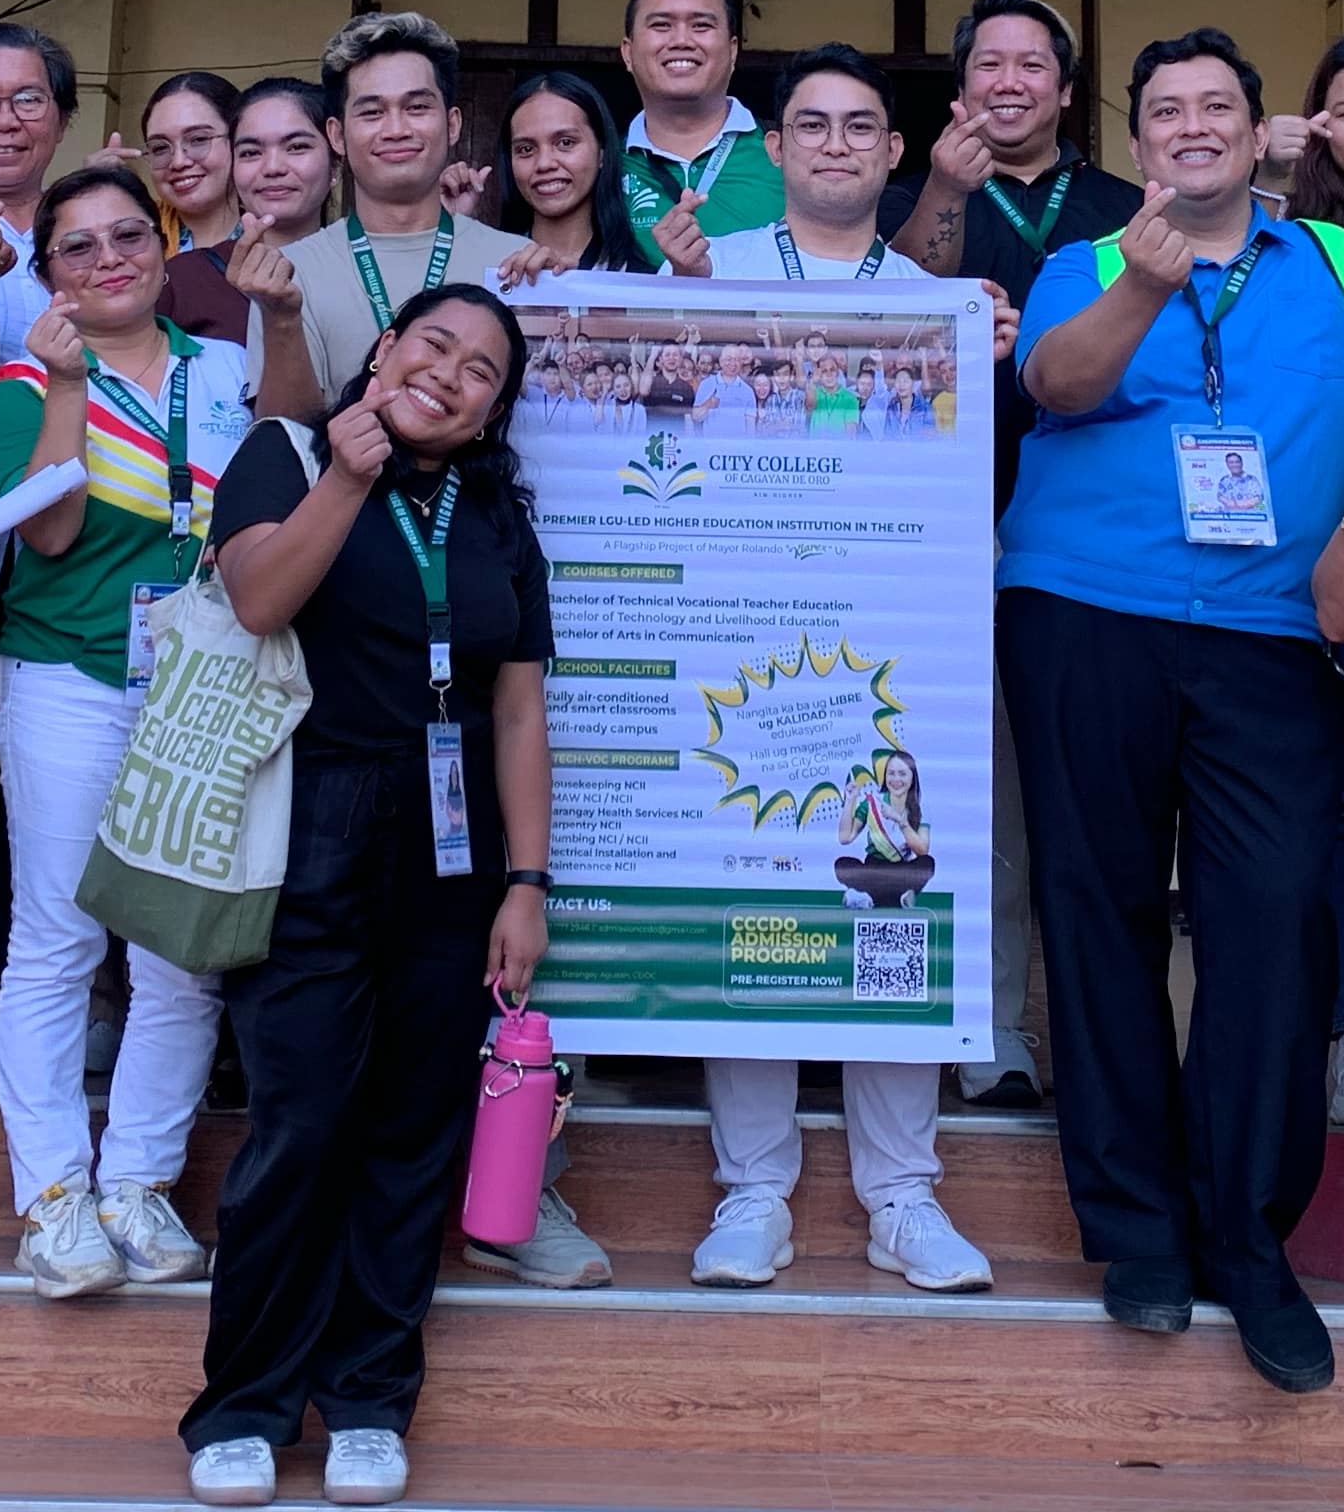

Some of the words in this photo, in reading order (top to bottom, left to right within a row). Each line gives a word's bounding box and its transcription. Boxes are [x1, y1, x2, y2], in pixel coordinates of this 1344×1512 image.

[778, 235, 792, 251] CITY
[360, 254, 372, 268] CITY
[425, 251, 446, 289] IGHER
[709, 455, 753, 471] CITY
[757, 456, 843, 474] COLLEGE
[725, 474, 738, 483] OF
[740, 474, 789, 484] CAGAYAN
[792, 475, 806, 484] DE
[808, 475, 830, 485] ORO
[436, 484, 458, 528] HIGHER
[532, 515, 539, 523] A
[543, 515, 596, 526] PREMIER
[600, 516, 650, 526] LGU-LED
[655, 517, 699, 528] HIGHER
[703, 518, 773, 529] EDUCATION
[777, 520, 851, 531] INSTITUTION
[855, 522, 867, 532] IN
[871, 522, 894, 532] THE
[898, 523, 924, 534] CITY
[604, 541, 611, 550] A
[613, 540, 656, 553] Flagship
[659, 541, 694, 553] Project
[696, 542, 706, 551] of
[708, 543, 739, 554] Mayor
[742, 543, 783, 553] Rolando
[835, 546, 848, 557] Uy
[563, 566, 618, 578] COURSES
[621, 568, 675, 579] OFFERED
[603, 595, 615, 606] of
[618, 596, 674, 606] Technical
[677, 597, 739, 608] Vocational
[743, 598, 788, 609] Teacher
[793, 600, 853, 611] Education
[603, 611, 614, 622] of
[618, 612, 685, 625] Technology
[689, 614, 711, 624] and
[715, 614, 776, 626] Livelihood
[780, 616, 839, 627] Education
[553, 629, 599, 639] achelor
[602, 629, 614, 640] of
[617, 630, 641, 640] Arts
[645, 630, 655, 641] in
[659, 631, 754, 643] Communication
[557, 662, 605, 673] SCHOOL
[609, 664, 670, 675] FACILITIES
[546, 690, 577, 704] Fully
[577, 691, 669, 703] air-conditioned
[546, 703, 567, 713] and
[571, 705, 605, 714] smart
[610, 705, 676, 715] classrooms
[737, 706, 779, 720] Nangita
[782, 703, 794, 713] ka
[796, 702, 810, 711] ba
[812, 700, 826, 709] ug
[829, 692, 862, 706] LIBRE
[759, 720, 773, 730] ug
[777, 710, 827, 727] KALIDAD
[830, 709, 843, 718] na
[547, 721, 607, 735] Wifi-ready
[610, 725, 658, 736] campus
[771, 721, 833, 740] edukasyon?
[790, 734, 862, 754] magpa-enroll
[167, 729, 223, 775] CEBU
[791, 757, 811, 768] City
[814, 749, 854, 763] College
[553, 753, 609, 764] TECH-VOC
[612, 755, 674, 766] PROGRAMS
[789, 770, 799, 781] of
[552, 780, 621, 792] ousekeeping
[624, 781, 646, 790] NCII
[583, 794, 601, 803] NCI
[611, 794, 632, 803] NCII
[552, 809, 597, 818] arangay
[598, 808, 632, 817] Health
[635, 808, 678, 818] Services
[681, 810, 703, 819] NCII
[553, 821, 597, 831] arpentry
[600, 821, 621, 830] NCII
[598, 835, 616, 844] NCI
[627, 835, 648, 845] NCII
[551, 848, 592, 857] lectrical
[595, 848, 653, 858] Installation
[656, 850, 676, 859] and
[615, 863, 636, 872] NCII
[588, 899, 612, 911] US:
[731, 916, 798, 932] CCCDO
[731, 932, 837, 948] ADMISSION
[731, 948, 826, 964] PROGRAM
[731, 975, 808, 985] PRE-REGISTER
[810, 976, 842, 986] NOW!
